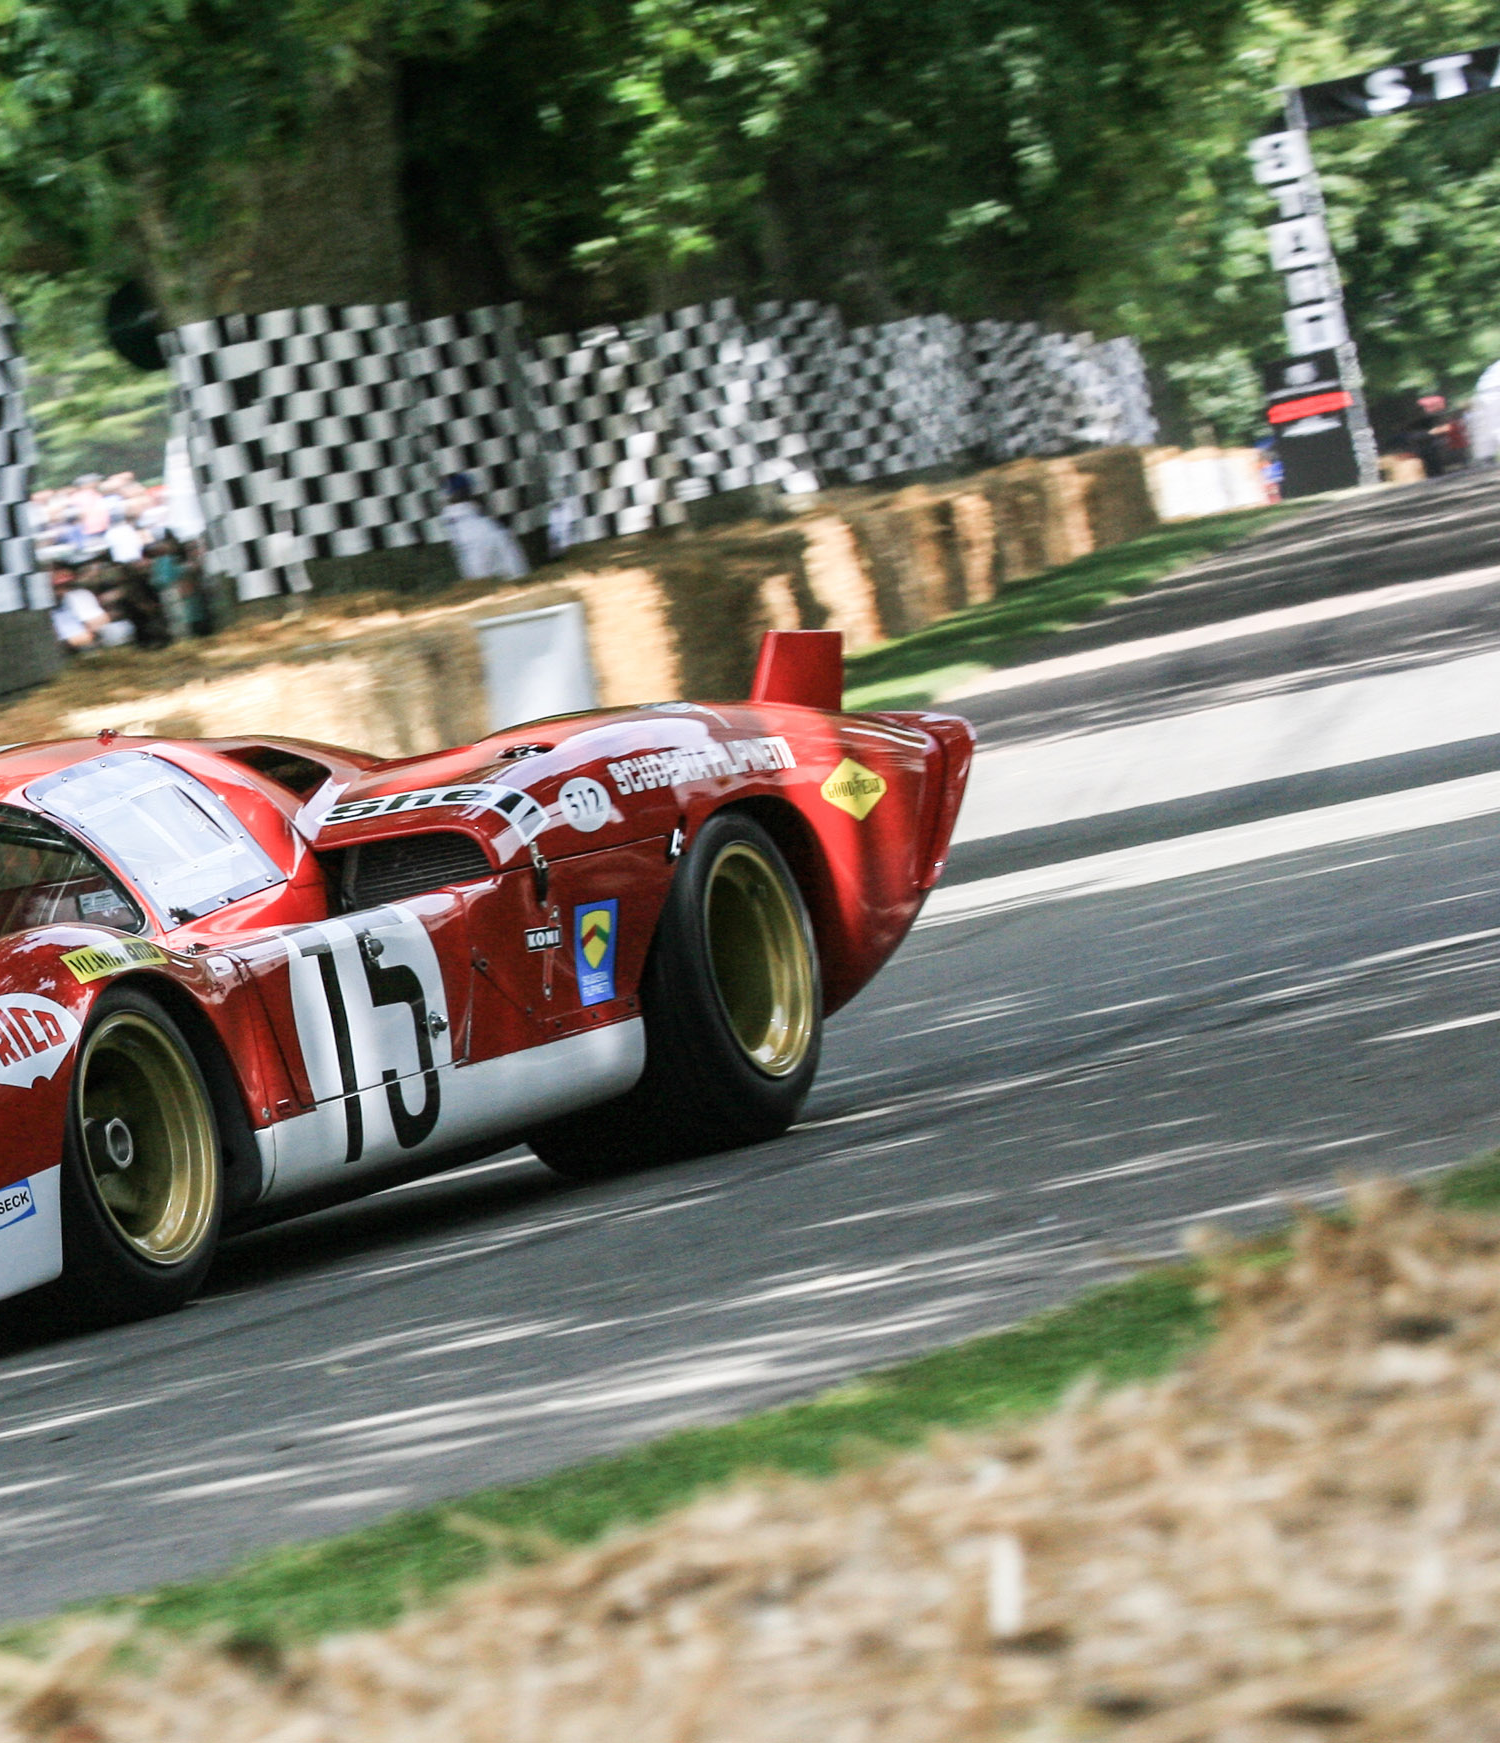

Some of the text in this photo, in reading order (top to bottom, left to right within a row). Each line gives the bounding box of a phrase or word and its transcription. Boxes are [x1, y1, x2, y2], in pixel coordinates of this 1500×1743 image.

[1364, 47, 1500, 113] ST
[565, 787, 603, 819] 512
[527, 929, 560, 948] KONI
[299, 931, 441, 1164] 15
